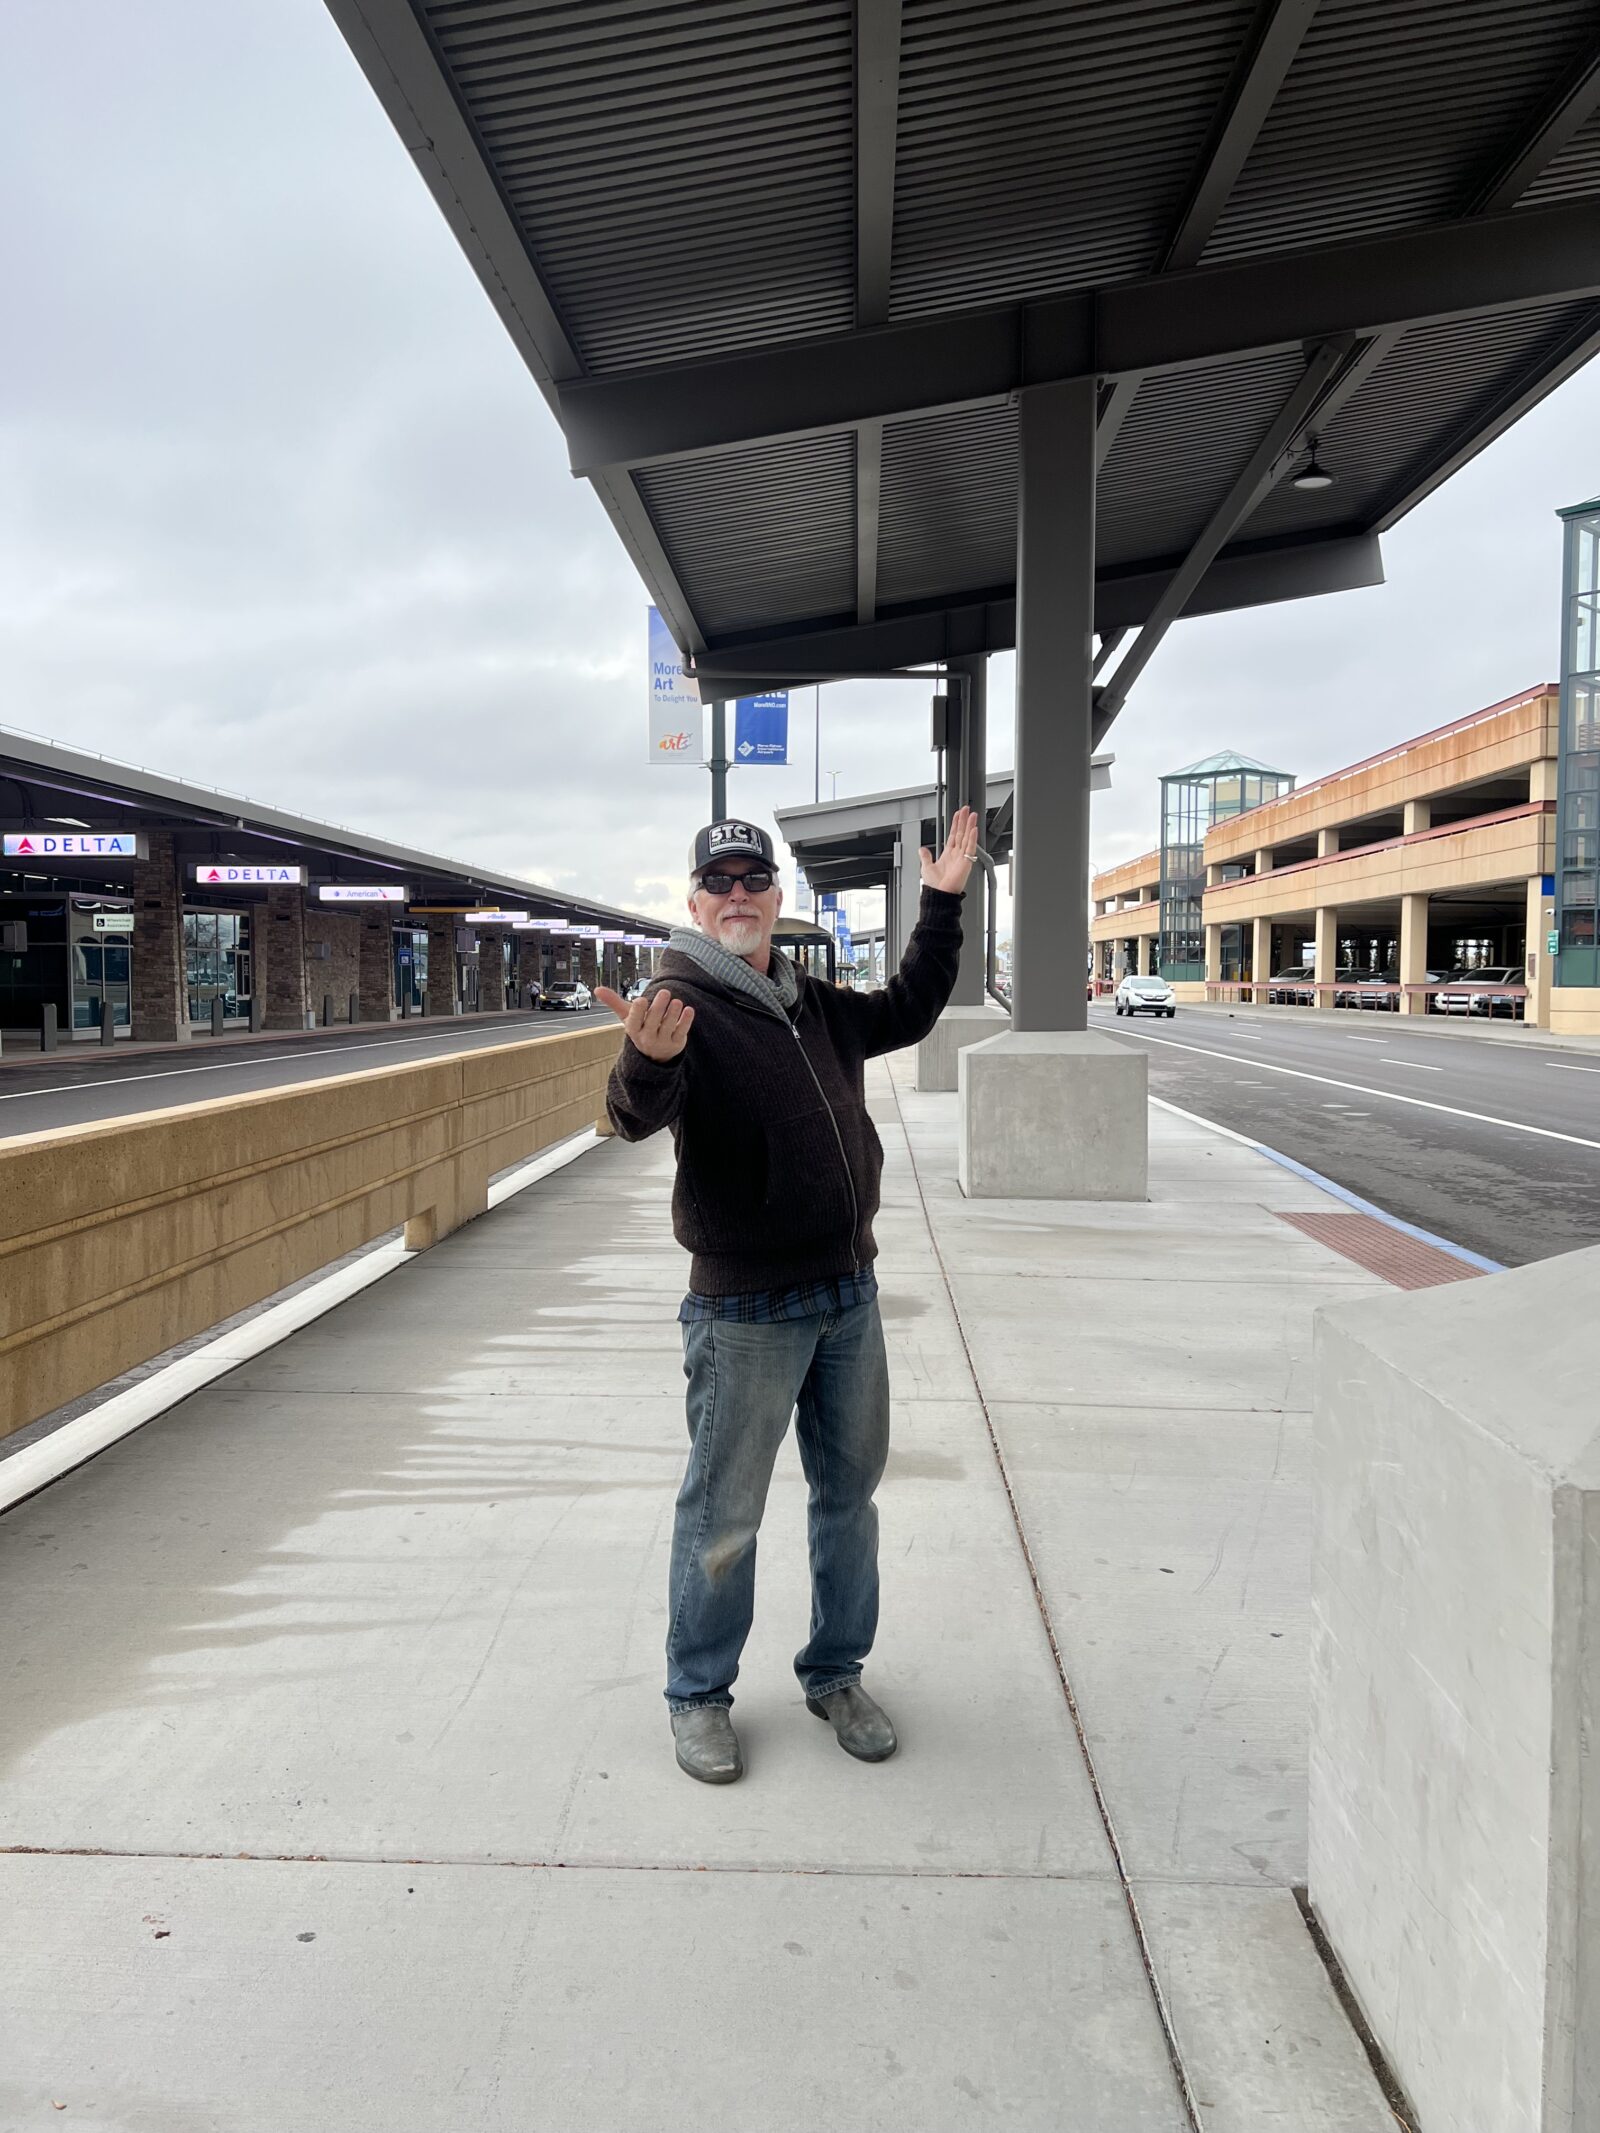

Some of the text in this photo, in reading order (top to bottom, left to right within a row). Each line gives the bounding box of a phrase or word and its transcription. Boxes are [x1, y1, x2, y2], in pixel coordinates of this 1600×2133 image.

[654, 662, 682, 675] More
[654, 677, 673, 690] Art
[654, 694, 662, 702] To
[663, 694, 685, 704] Delight
[43, 838, 122, 852] DELTA
[227, 868, 290, 881] DELTA
[346, 890, 379, 898] American
